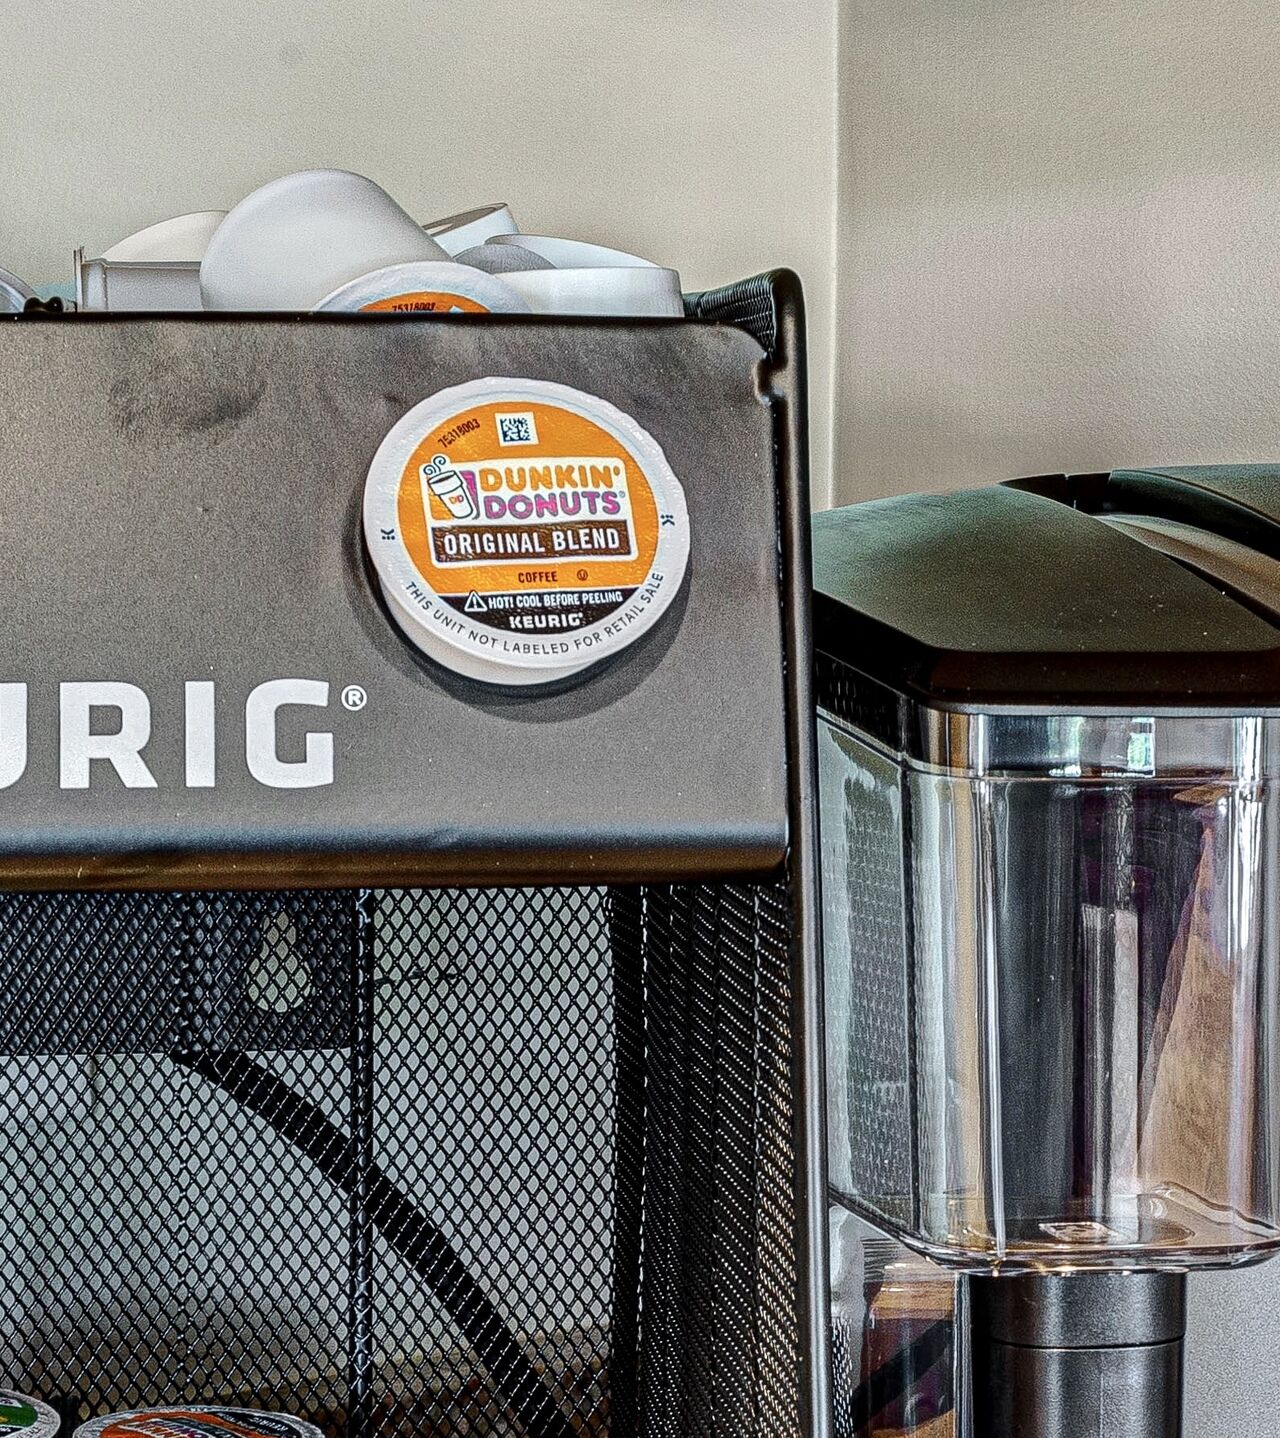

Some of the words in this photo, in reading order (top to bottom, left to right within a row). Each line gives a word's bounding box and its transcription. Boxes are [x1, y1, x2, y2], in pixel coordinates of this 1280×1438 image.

[479, 466, 621, 491] DUNKIN'
[444, 531, 544, 556] ORIGINAL
[554, 528, 620, 550] BLEND
[518, 571, 558, 583] COFFEE
[488, 597, 515, 609] HOT!
[516, 595, 542, 608] COOL
[544, 593, 580, 606] BEFORE
[582, 591, 623, 604] PEELING
[406, 581, 433, 611] THIS
[434, 609, 465, 635] UNIT
[468, 630, 497, 648] NOT
[504, 641, 569, 655] LABELED
[574, 632, 603, 650] FOR
[605, 603, 643, 636] RETAIL
[642, 571, 664, 603] SALE
[509, 612, 583, 629] KEURIG
